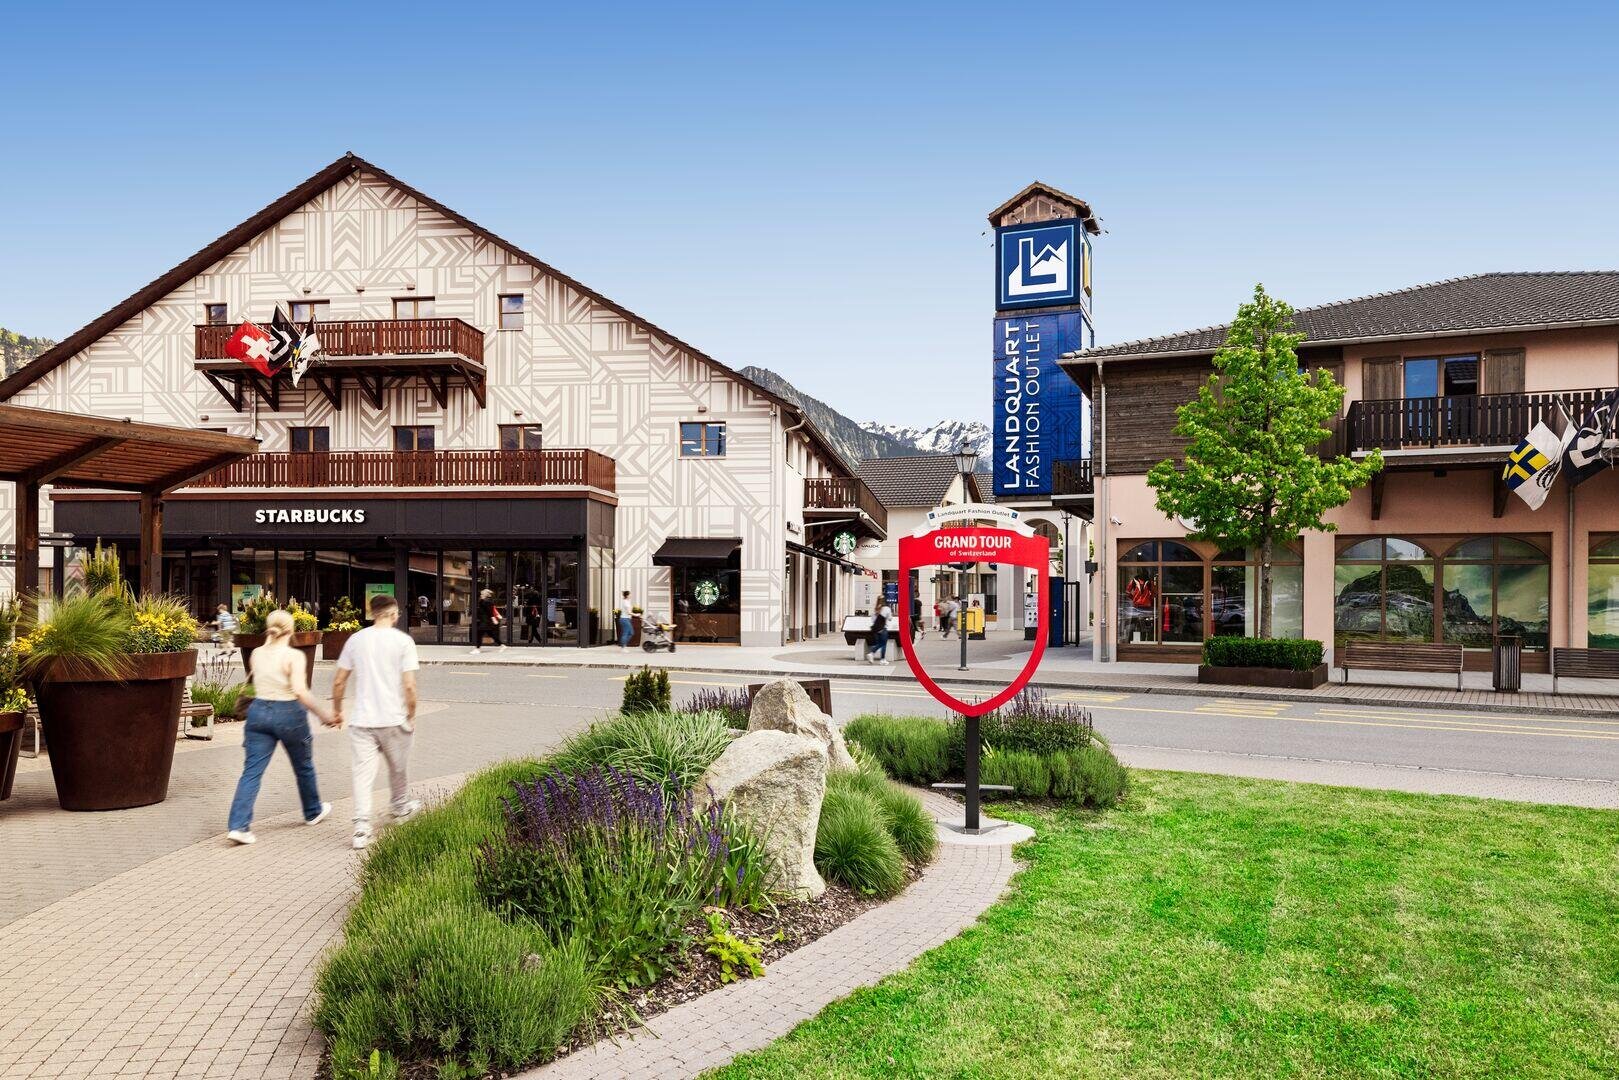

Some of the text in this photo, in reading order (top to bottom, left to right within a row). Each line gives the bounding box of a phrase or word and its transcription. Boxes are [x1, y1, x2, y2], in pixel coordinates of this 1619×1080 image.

[1004, 322, 1021, 488] LANDQUART
[1026, 321, 1040, 488] FASHION OUTLET
[255, 509, 365, 523] STARBUCKS
[935, 535, 1011, 548] GRAND TOUR
